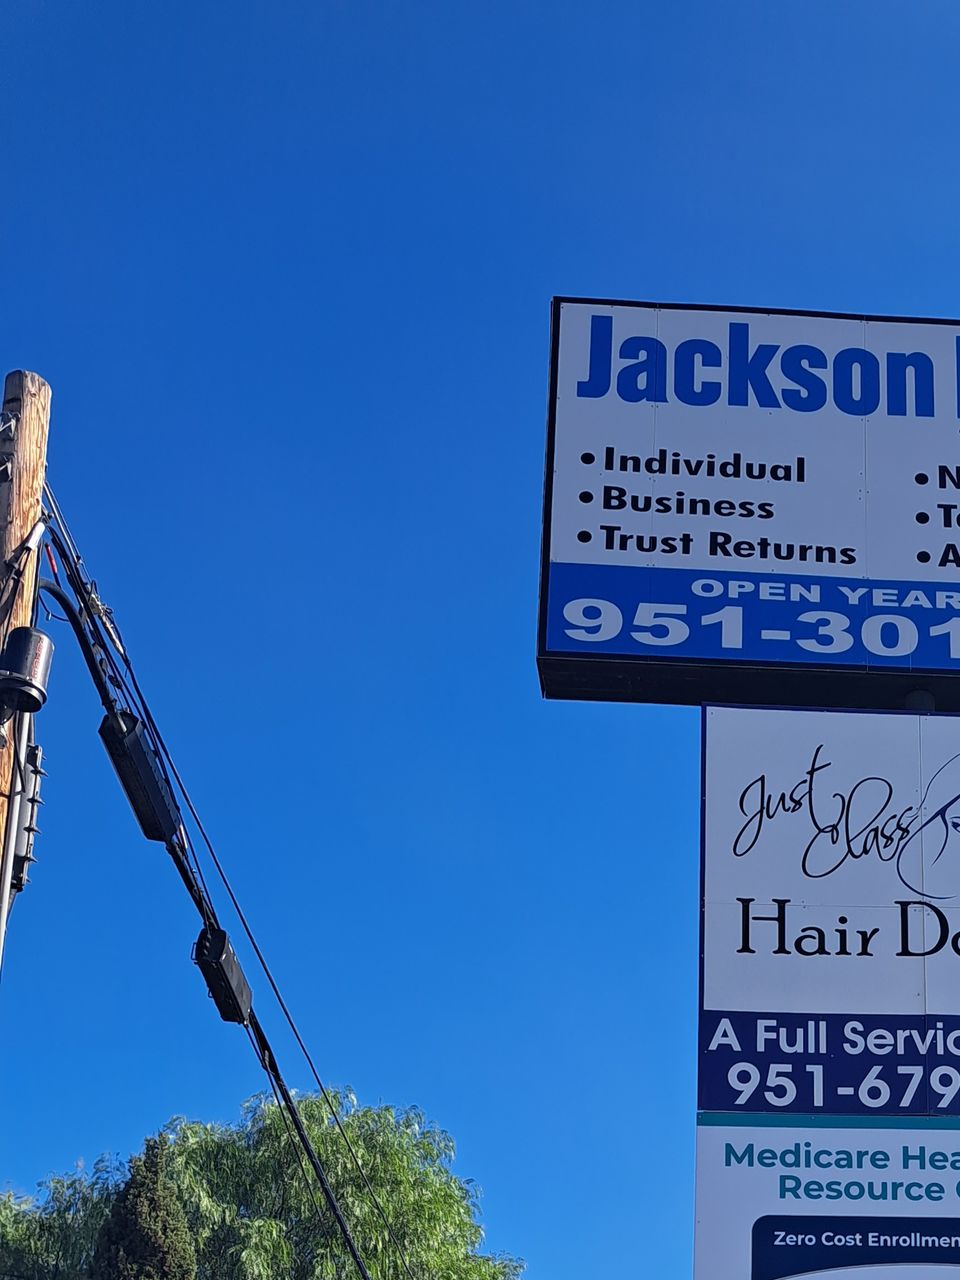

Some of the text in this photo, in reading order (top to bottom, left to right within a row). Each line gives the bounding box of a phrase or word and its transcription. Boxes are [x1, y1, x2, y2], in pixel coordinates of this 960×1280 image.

[576, 314, 935, 418] Jackson
[603, 446, 806, 484] Individual
[602, 486, 776, 521] Business
[599, 525, 858, 566] Trust Returns
[691, 579, 823, 603] OPEN
[733, 744, 832, 857] Just
[801, 776, 919, 878] Class
[735, 897, 880, 957] Hair
[708, 1018, 742, 1052] A
[757, 1019, 827, 1054] Full
[723, 1141, 890, 1170] Medicare
[778, 1175, 946, 1201] Resource
[773, 1230, 817, 1247] Zero
[821, 1231, 863, 1248] Cost
